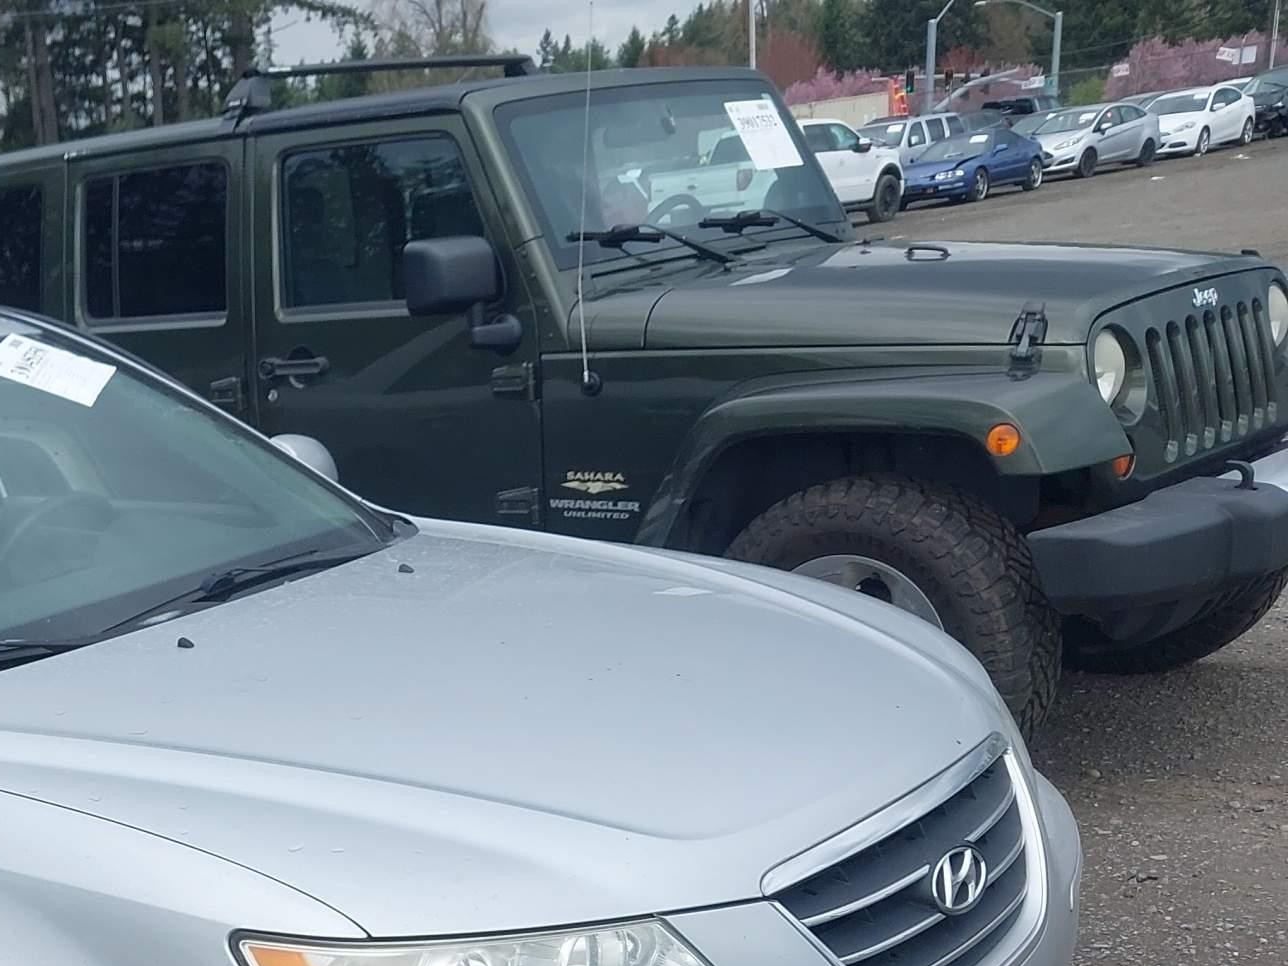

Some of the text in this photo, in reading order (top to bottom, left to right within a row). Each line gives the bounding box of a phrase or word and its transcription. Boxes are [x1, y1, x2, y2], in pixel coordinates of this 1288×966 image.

[1192, 287, 1218, 307] Jeep
[566, 471, 625, 482] SAHARA
[549, 499, 640, 512] WRANGLER
[563, 510, 630, 519] UNLIMITED
